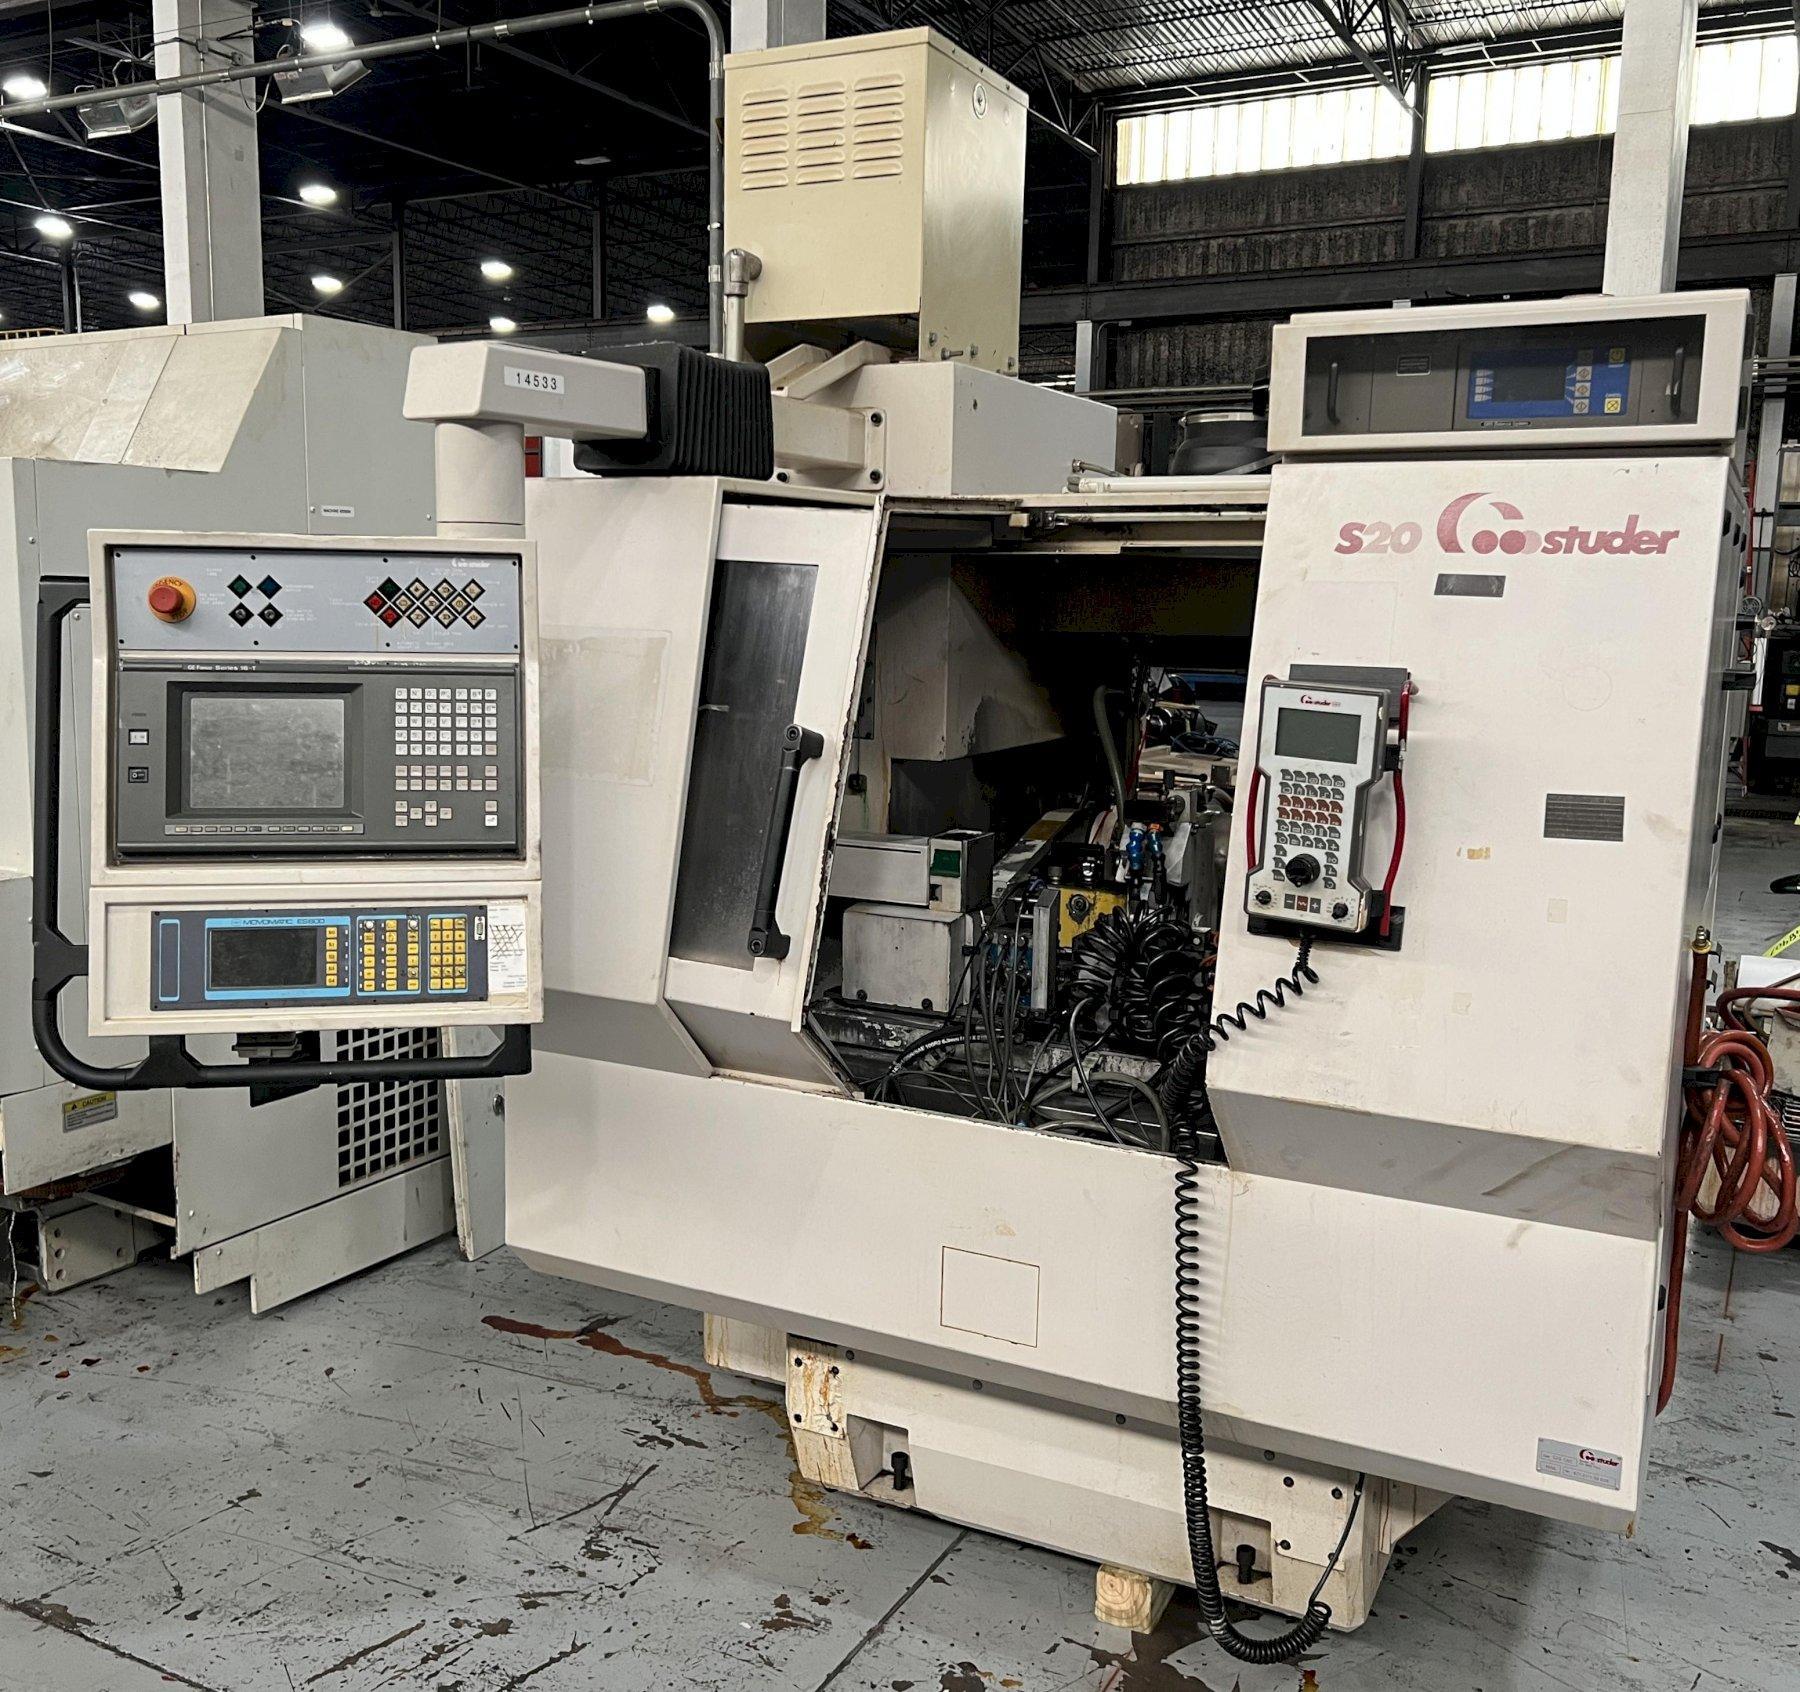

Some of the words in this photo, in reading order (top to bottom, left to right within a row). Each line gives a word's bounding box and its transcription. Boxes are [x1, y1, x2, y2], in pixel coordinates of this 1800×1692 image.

[516, 372, 557, 390] 14533
[1334, 521, 1422, 555] S20
[1541, 514, 1680, 555] studer
[83, 1095, 107, 1107] CAUTION
